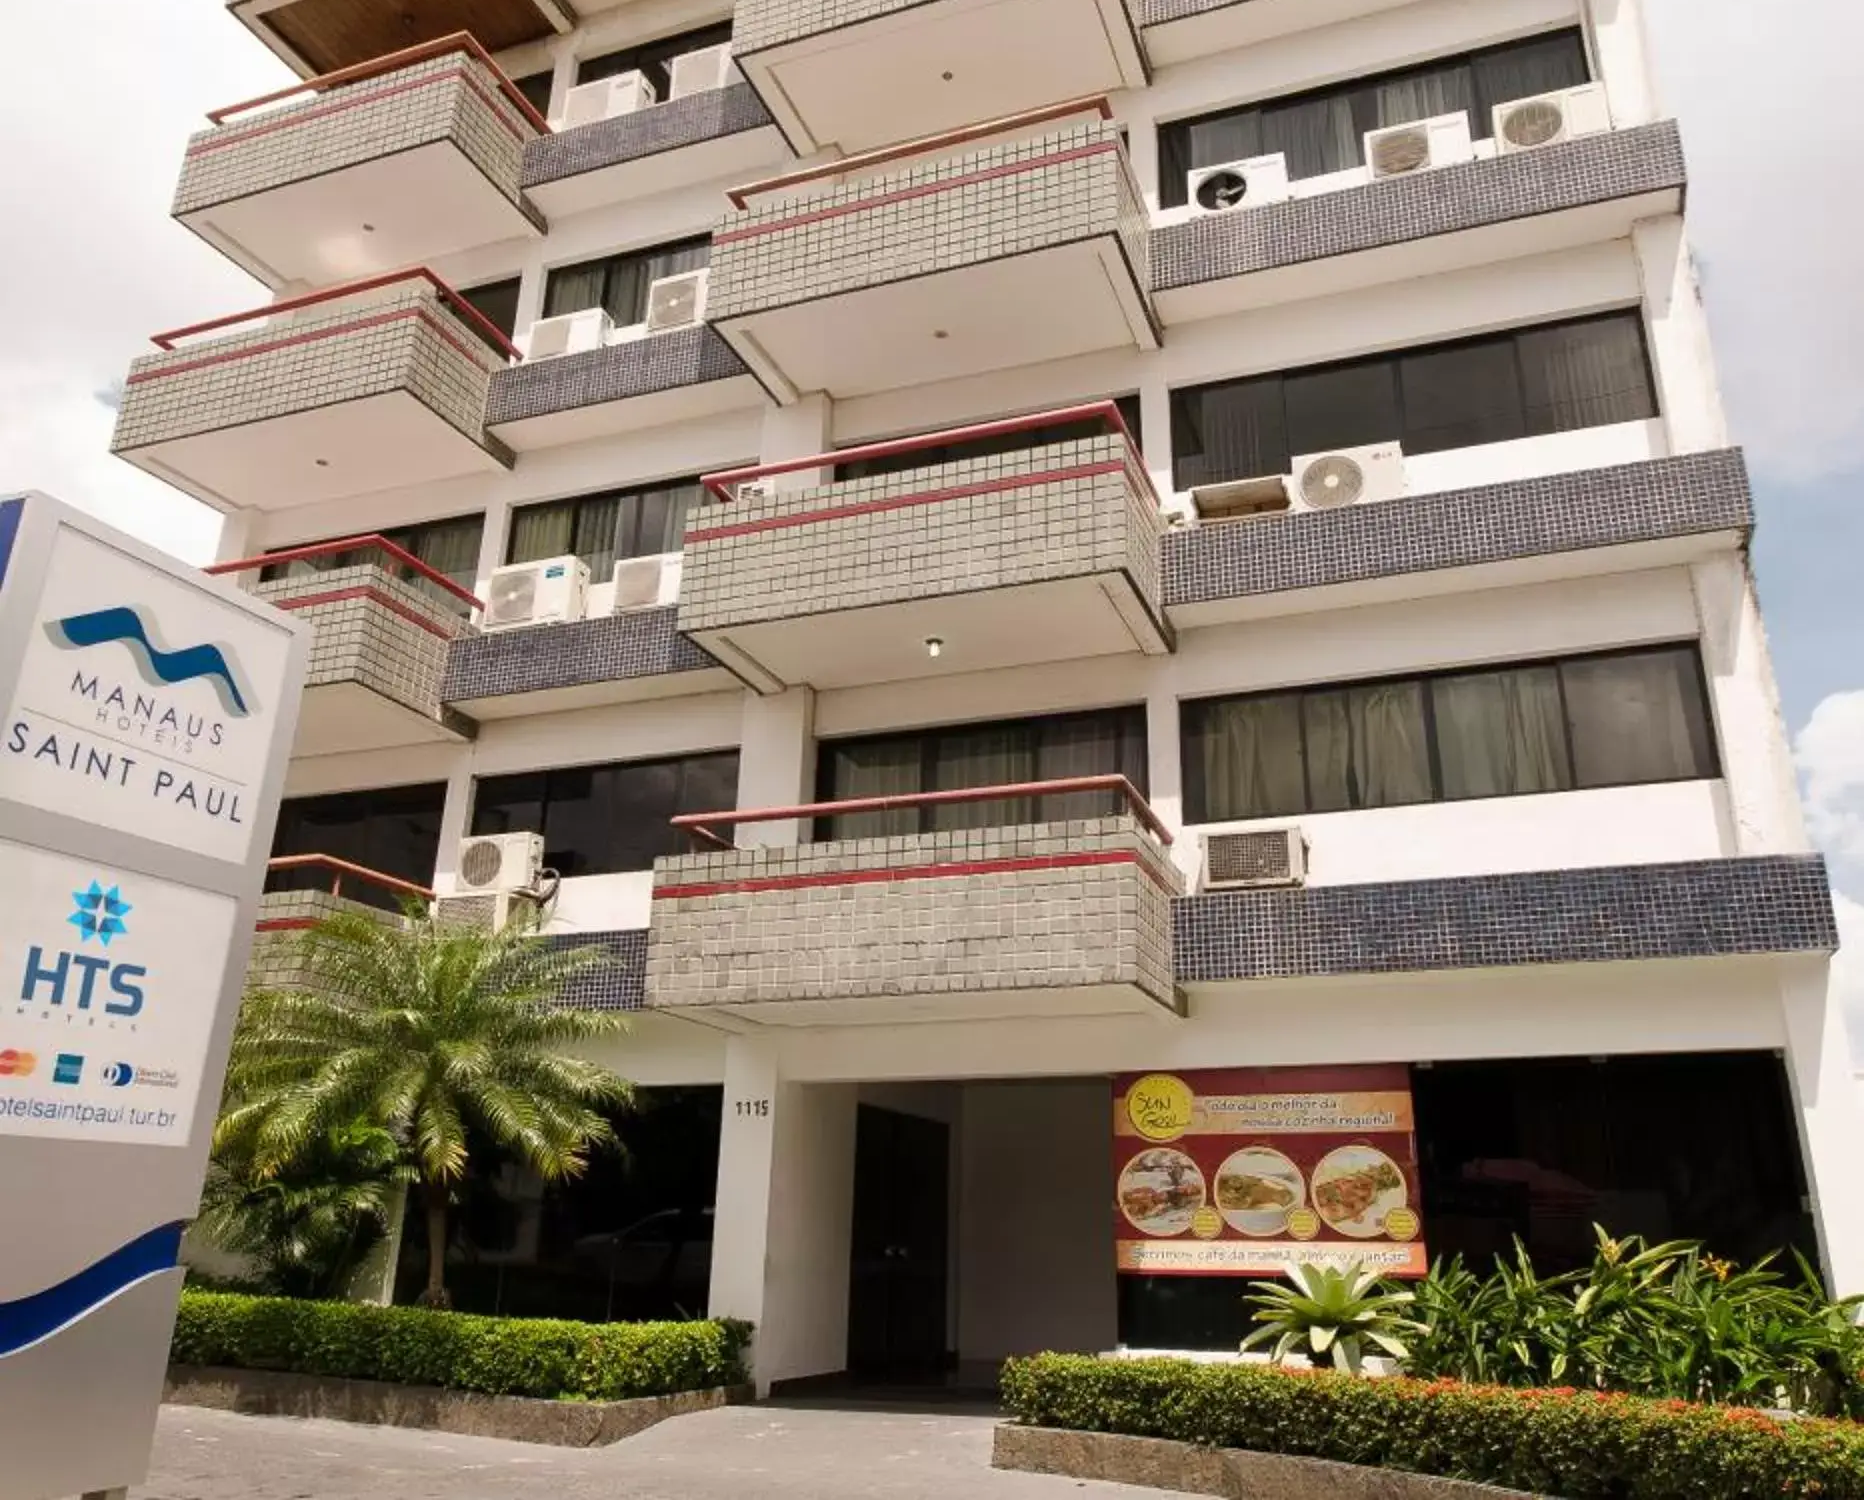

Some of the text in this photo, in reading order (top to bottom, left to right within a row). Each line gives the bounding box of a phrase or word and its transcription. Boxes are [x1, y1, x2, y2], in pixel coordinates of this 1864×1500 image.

[70, 670, 225, 747] MANAUS
[8, 722, 242, 823] SAINT PAUL
[21, 945, 147, 1017] HTS
[736, 1100, 769, 1116] 1115
